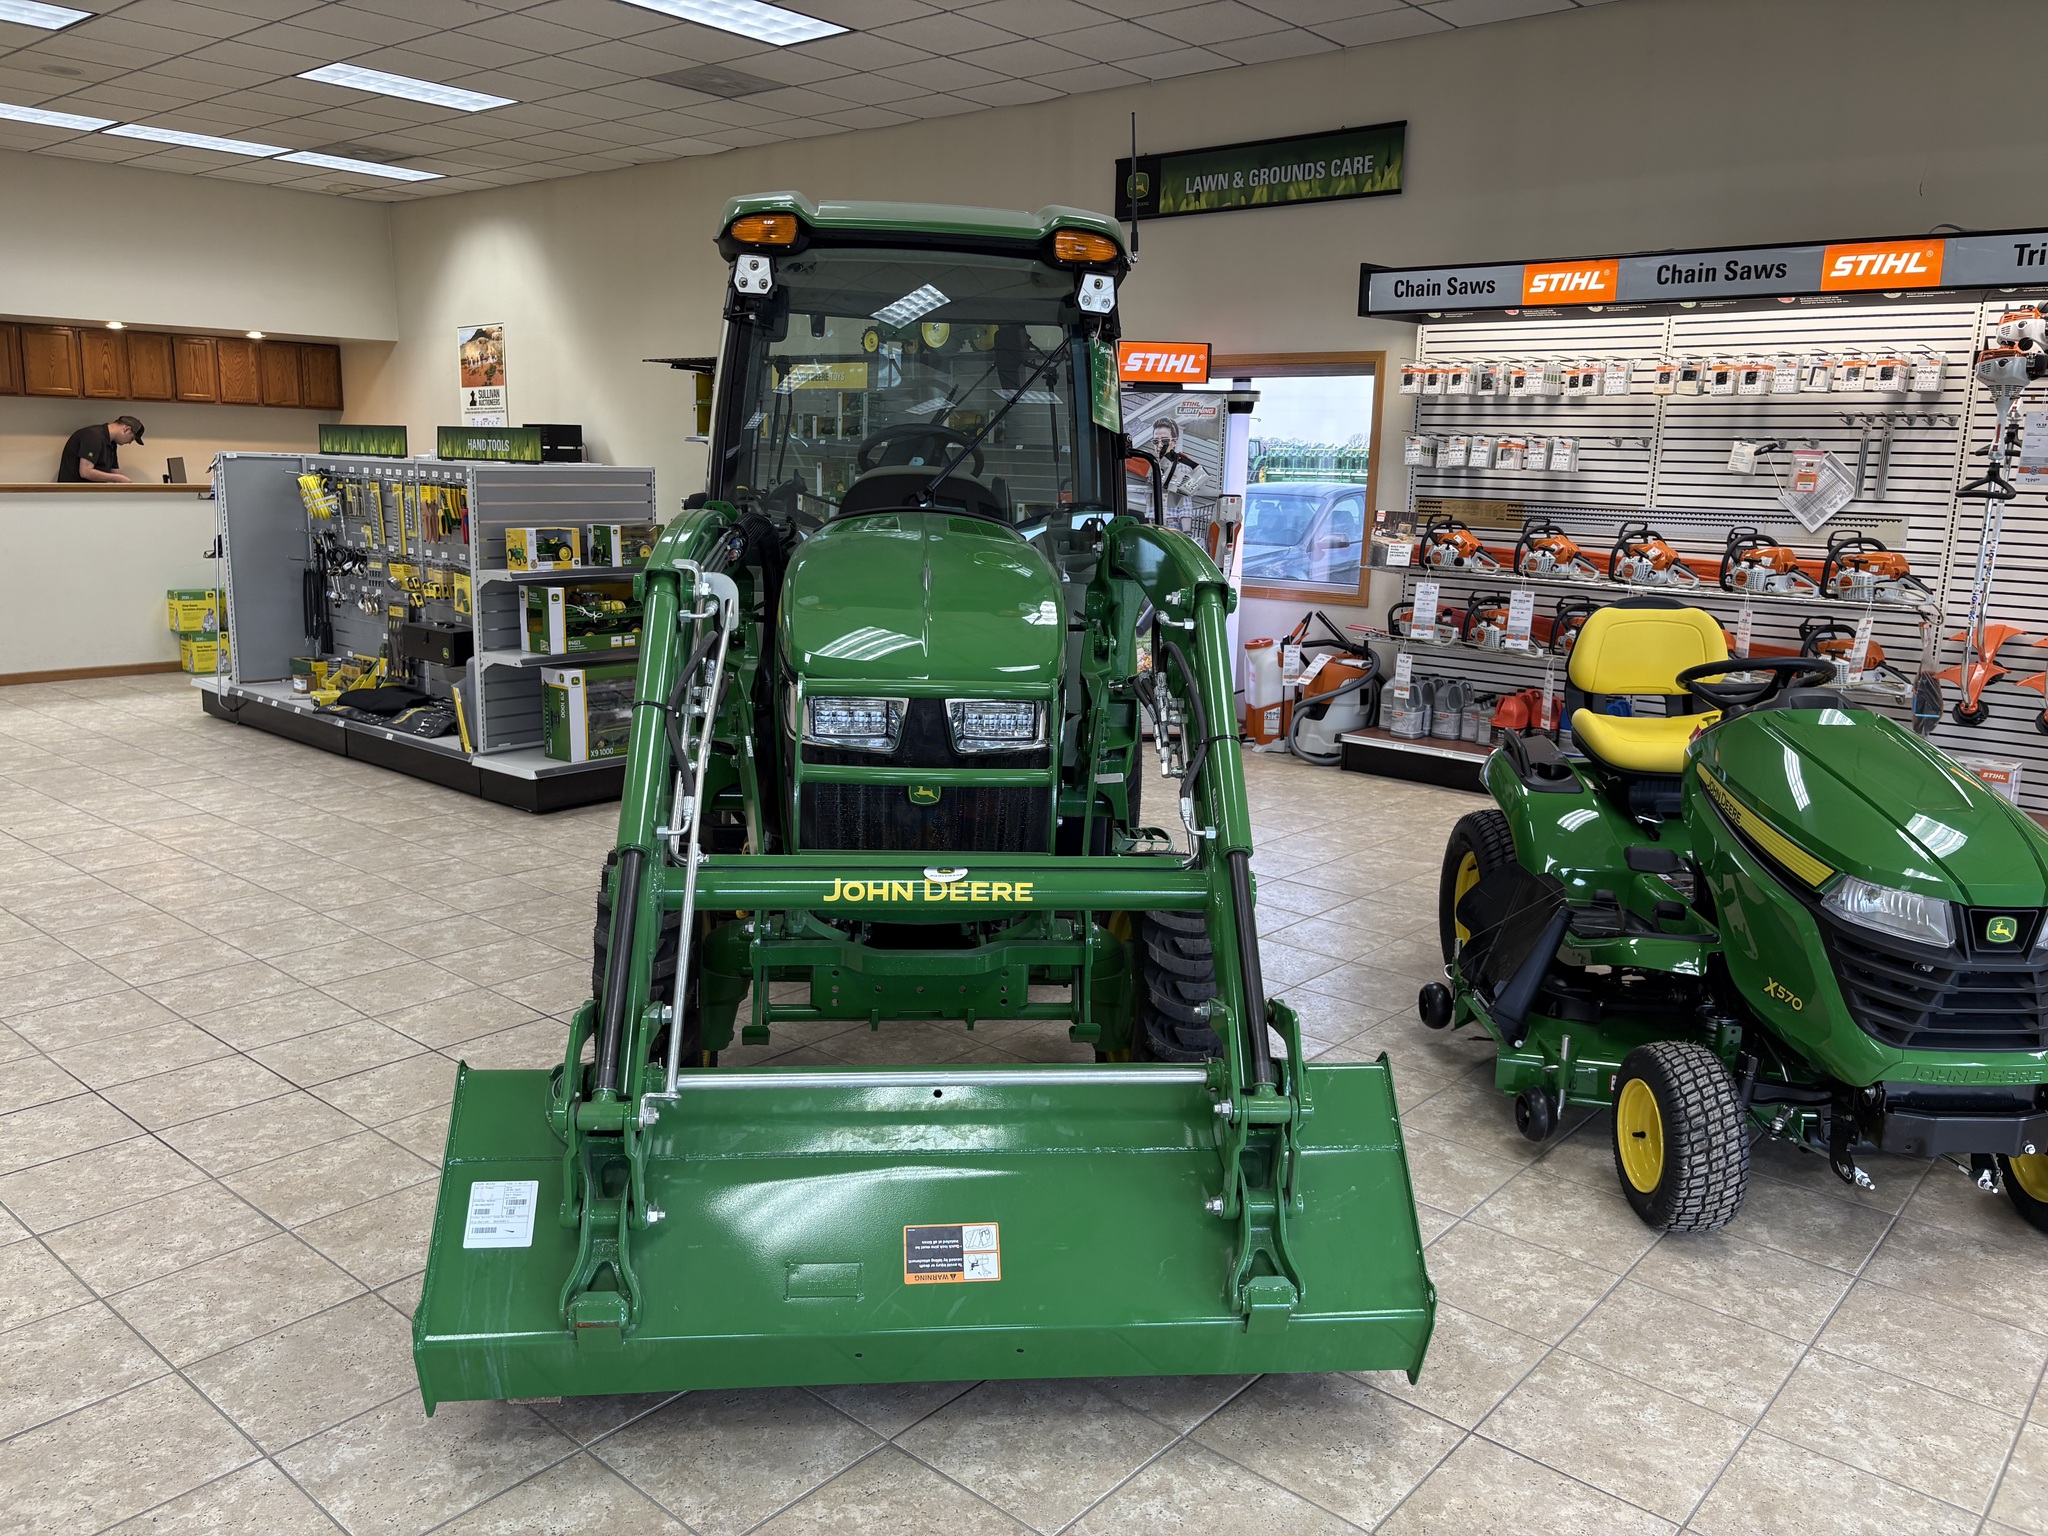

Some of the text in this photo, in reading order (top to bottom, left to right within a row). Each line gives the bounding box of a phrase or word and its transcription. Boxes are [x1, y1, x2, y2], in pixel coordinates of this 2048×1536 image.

[1185, 154, 1374, 194] LAWN & GROUNDS CARE
[1656, 260, 1787, 285] Chain Saws
[1830, 251, 1928, 277] STIHL
[1394, 276, 1496, 298] Chain Saws
[1529, 270, 1606, 293] STIHL
[1124, 352, 1202, 374] STIHL
[478, 389, 500, 398] SULLIVAN
[1178, 406, 1215, 415] LIGHTNING
[467, 438, 510, 452] HAND TOOLS
[590, 747, 614, 757] X9 1000
[1982, 772, 2006, 780] STIHL
[1706, 776, 1742, 826] JOHN DEERE
[823, 877, 1034, 902] JOHN DEERE
[1763, 976, 1803, 1011] X570
[1901, 1066, 2044, 1083] JOHN DEERE
[914, 1274, 949, 1282] WARNING
